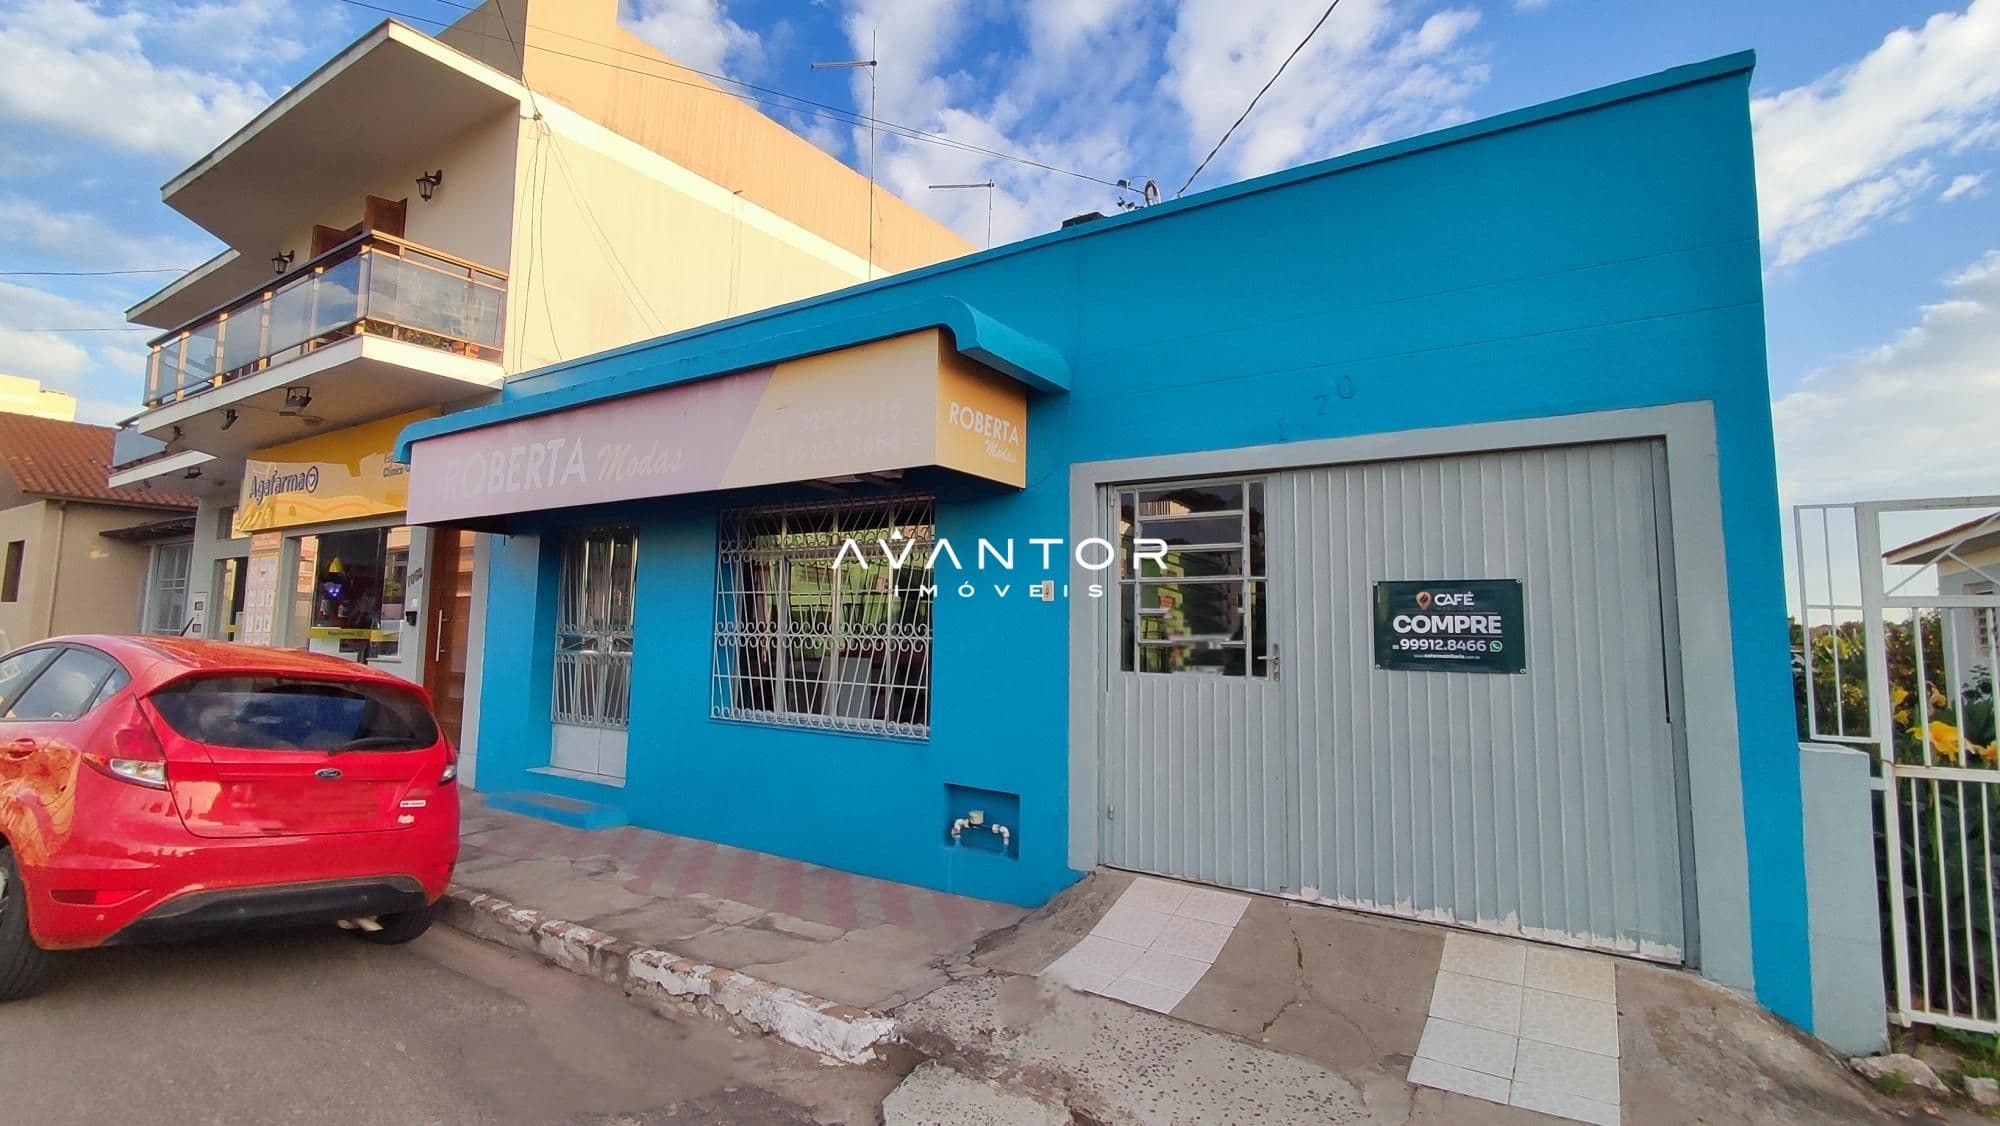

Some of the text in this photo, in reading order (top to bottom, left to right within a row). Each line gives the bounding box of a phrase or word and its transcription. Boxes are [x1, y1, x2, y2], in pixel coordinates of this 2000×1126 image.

[949, 401, 1019, 447] ROBERTA
[443, 436, 683, 503] ROBERTA Modas
[249, 470, 305, 506] Agafarma
[1434, 591, 1475, 606] CAFÉ
[1393, 615, 1502, 634] COMPRE
[1400, 638, 1487, 652] 99912.8466
